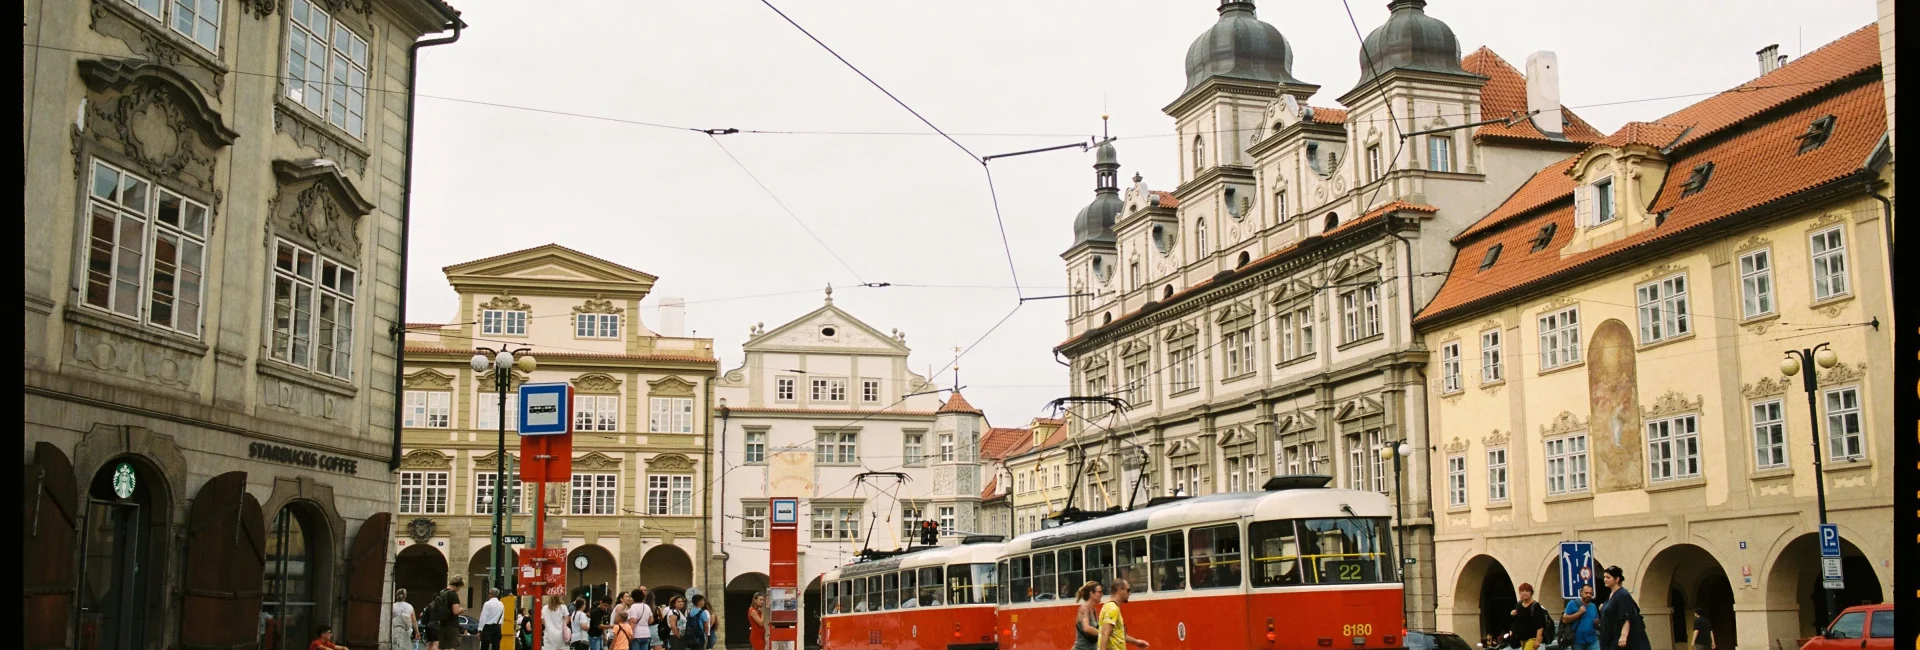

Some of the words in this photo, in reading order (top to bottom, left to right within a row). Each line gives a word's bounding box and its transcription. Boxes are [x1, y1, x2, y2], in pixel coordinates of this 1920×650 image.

[248, 442, 318, 467] STARBUCKS
[319, 455, 358, 474] COFFEE
[1824, 527, 1835, 546] P
[1339, 564, 1362, 580] 22
[1343, 624, 1372, 637] 8180
